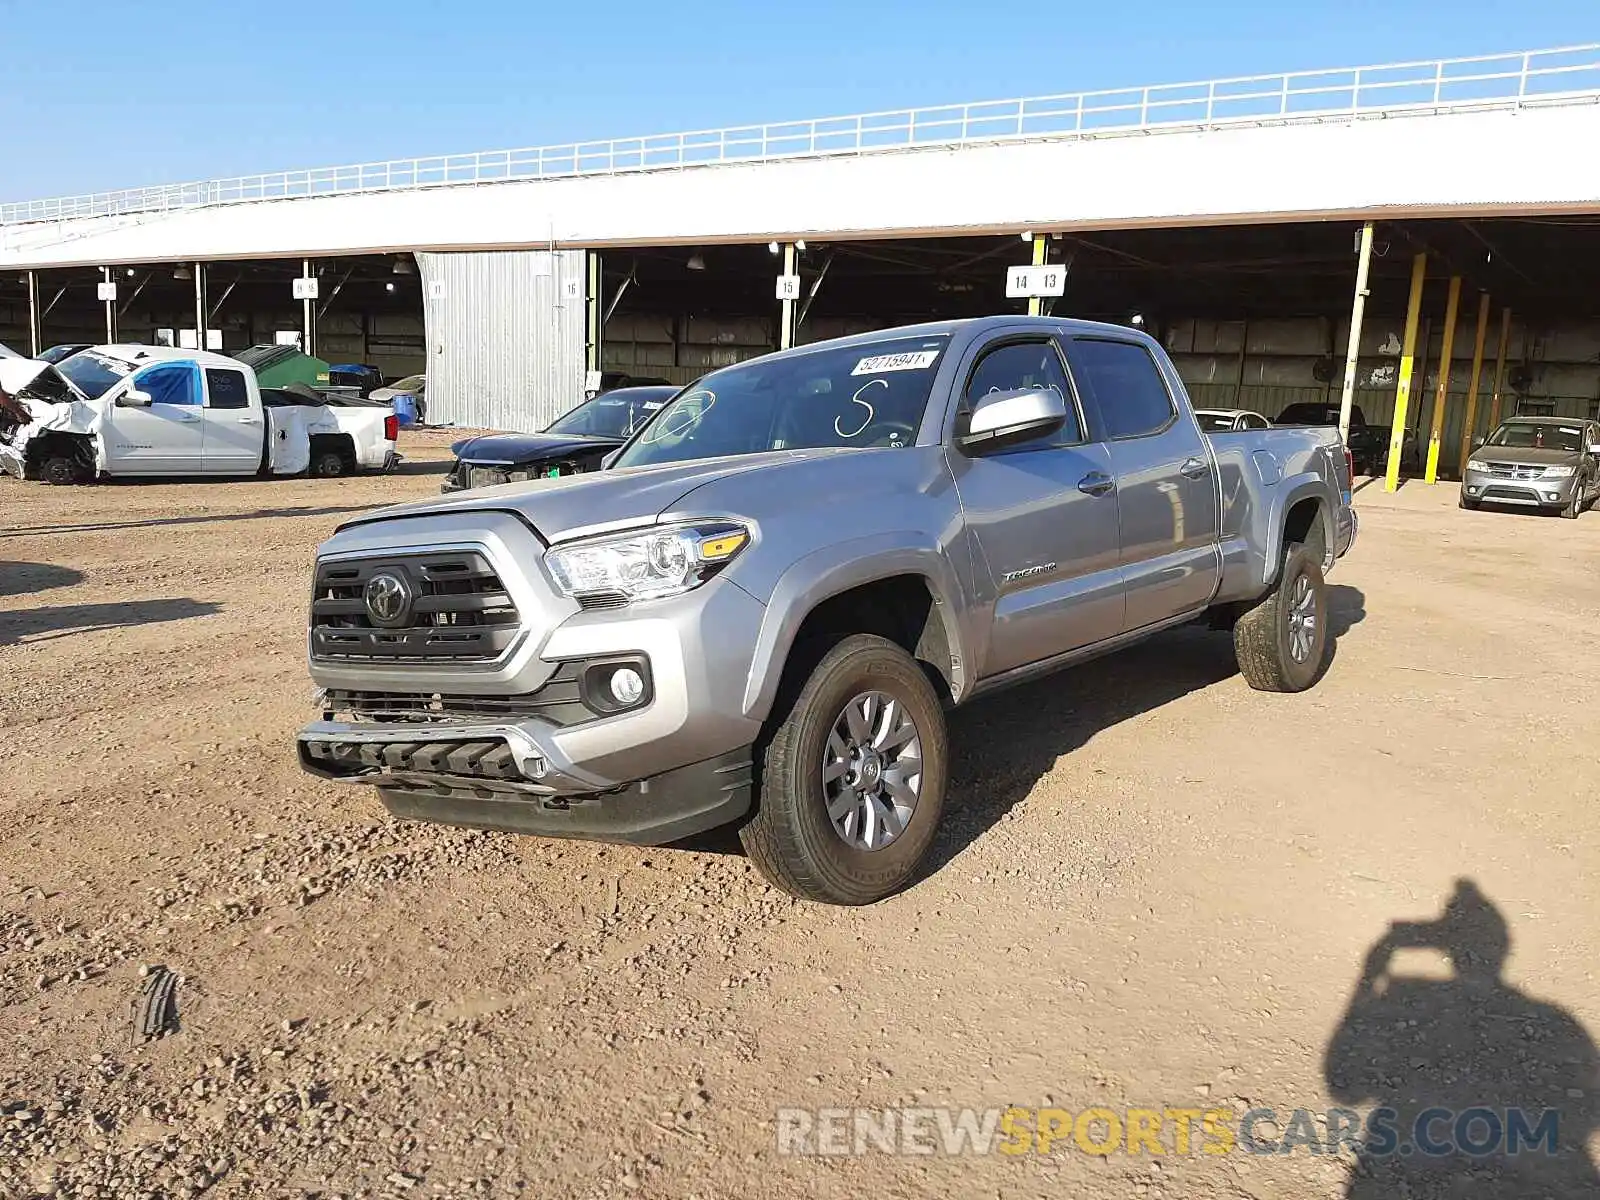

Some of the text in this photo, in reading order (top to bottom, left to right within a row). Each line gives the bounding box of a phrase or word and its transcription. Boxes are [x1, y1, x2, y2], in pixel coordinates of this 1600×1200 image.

[783, 280, 793, 293] 15
[1015, 273, 1057, 289] 14 13
